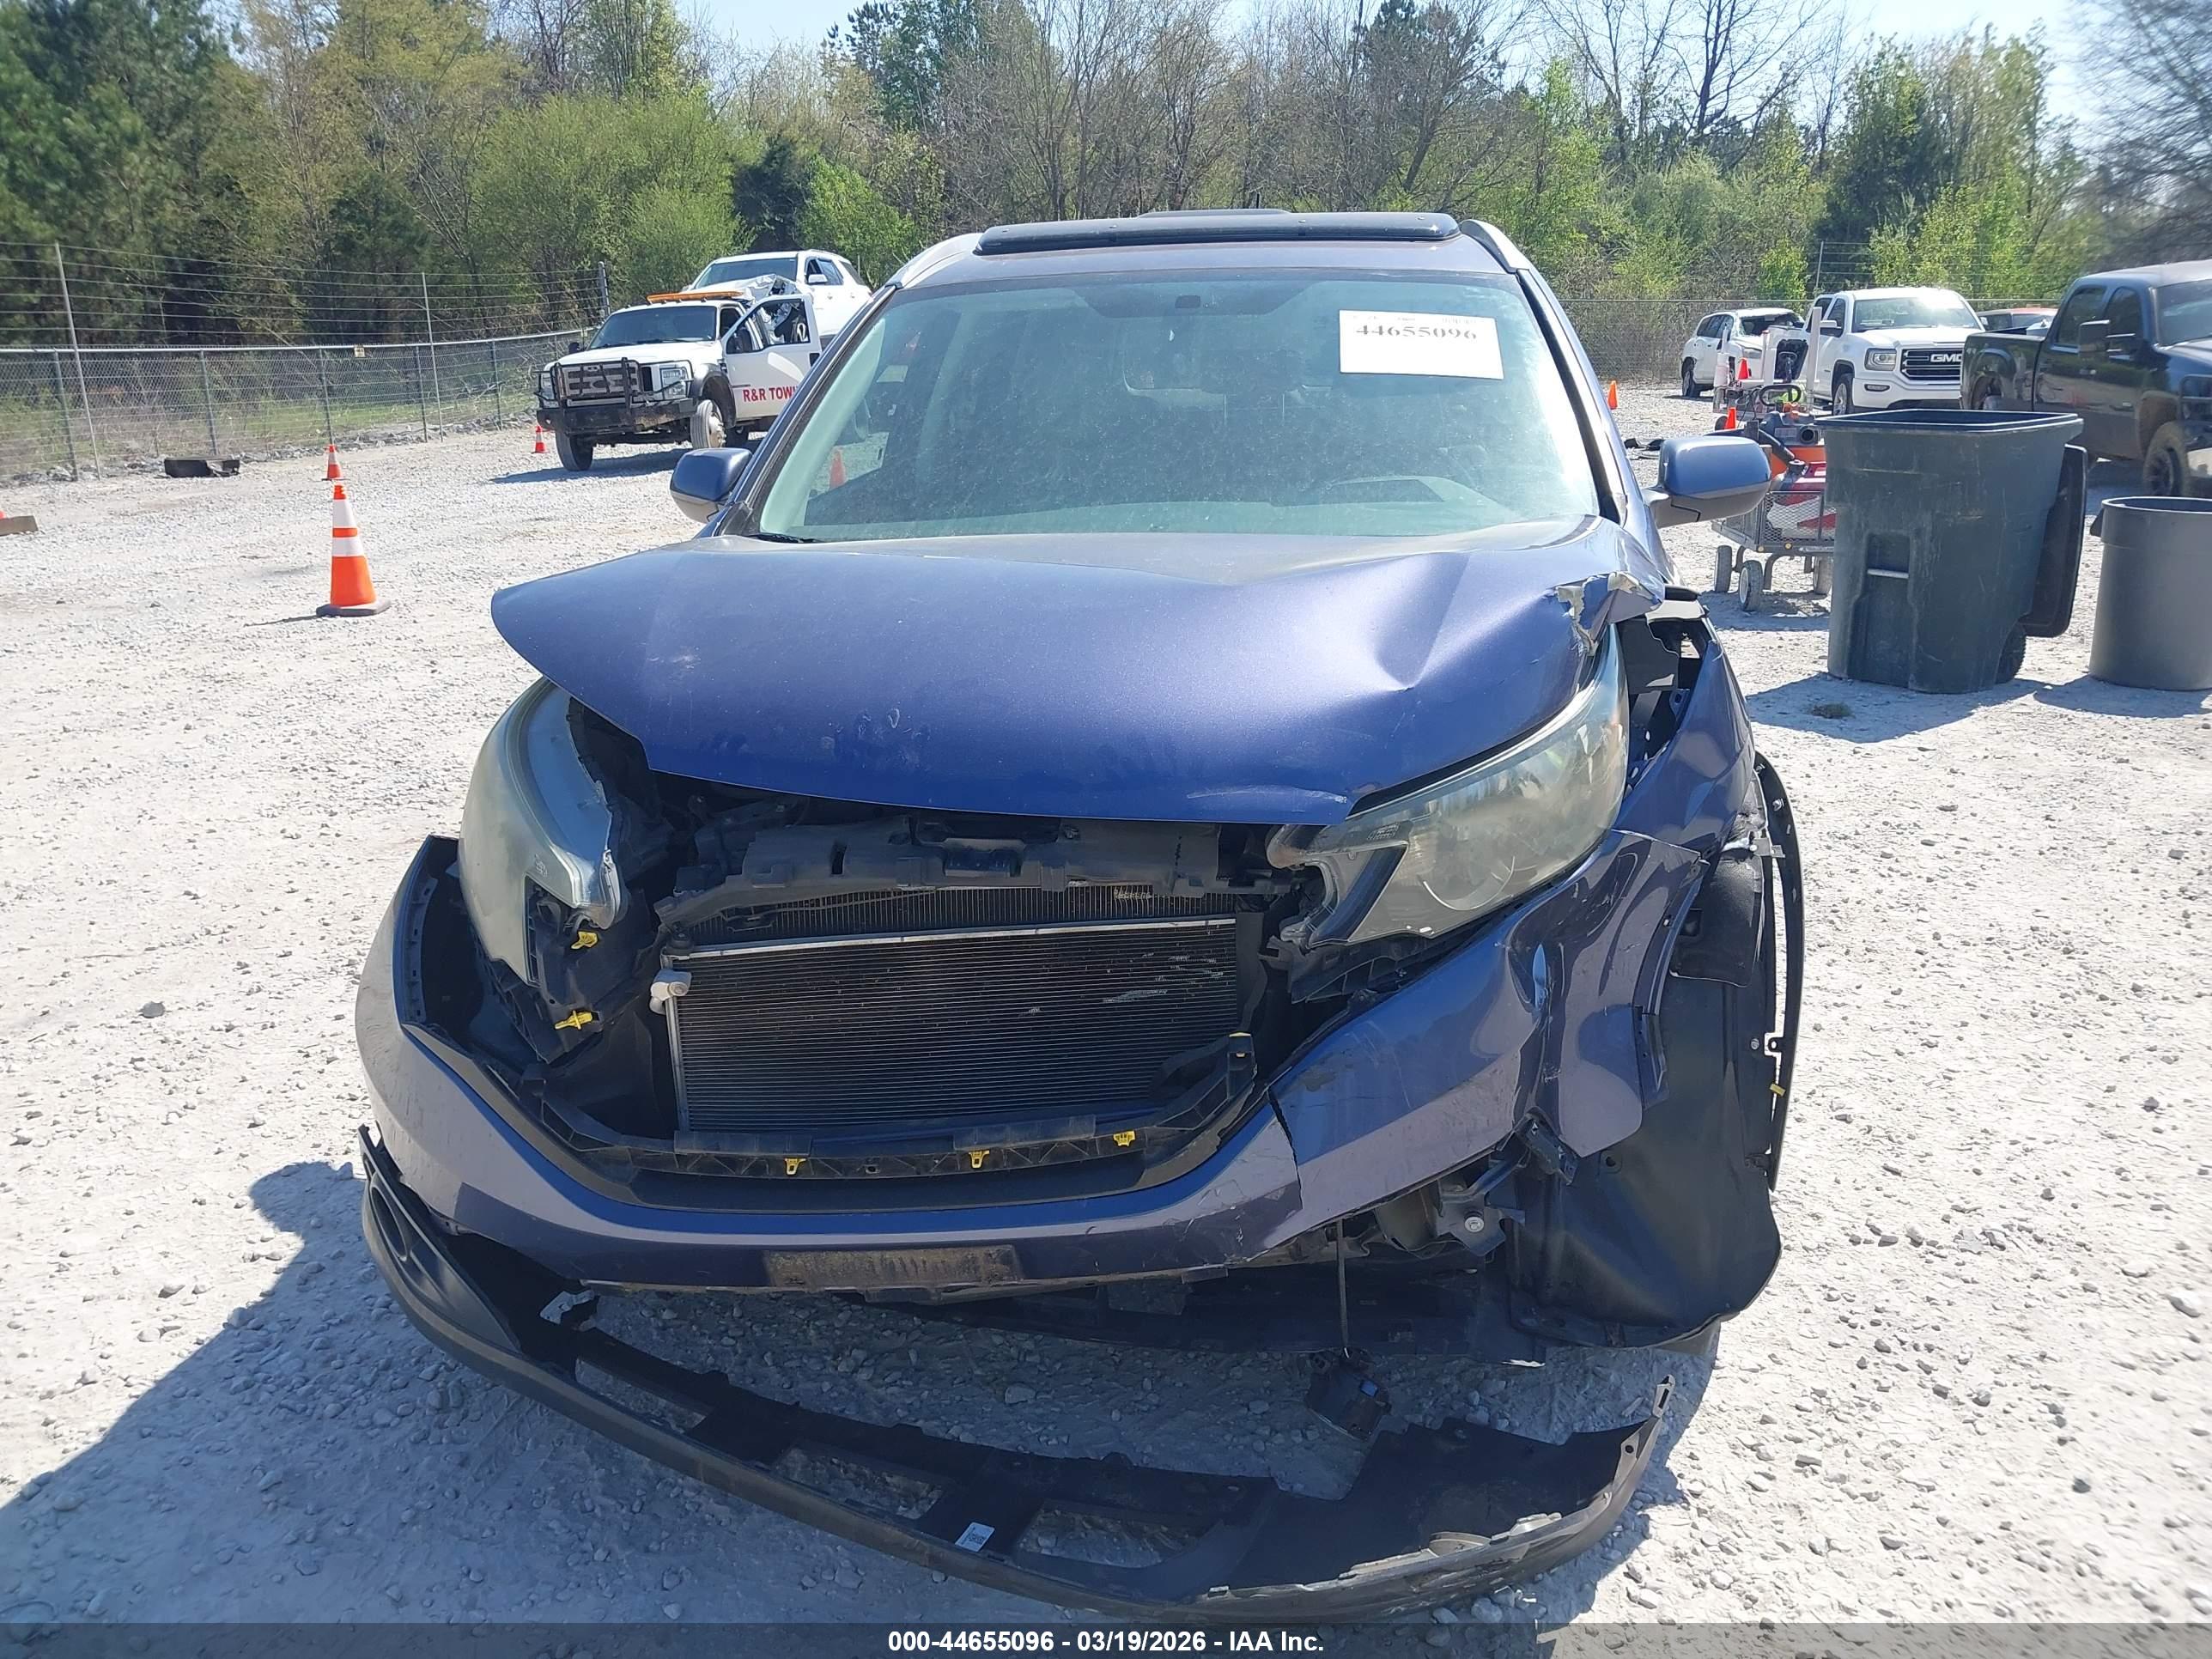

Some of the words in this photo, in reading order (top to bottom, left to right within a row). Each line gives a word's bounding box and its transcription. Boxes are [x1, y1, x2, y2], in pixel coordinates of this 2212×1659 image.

[1355, 324, 1477, 340] 44655096
[742, 388, 767, 402] R&R
[769, 386, 798, 400] TOW
